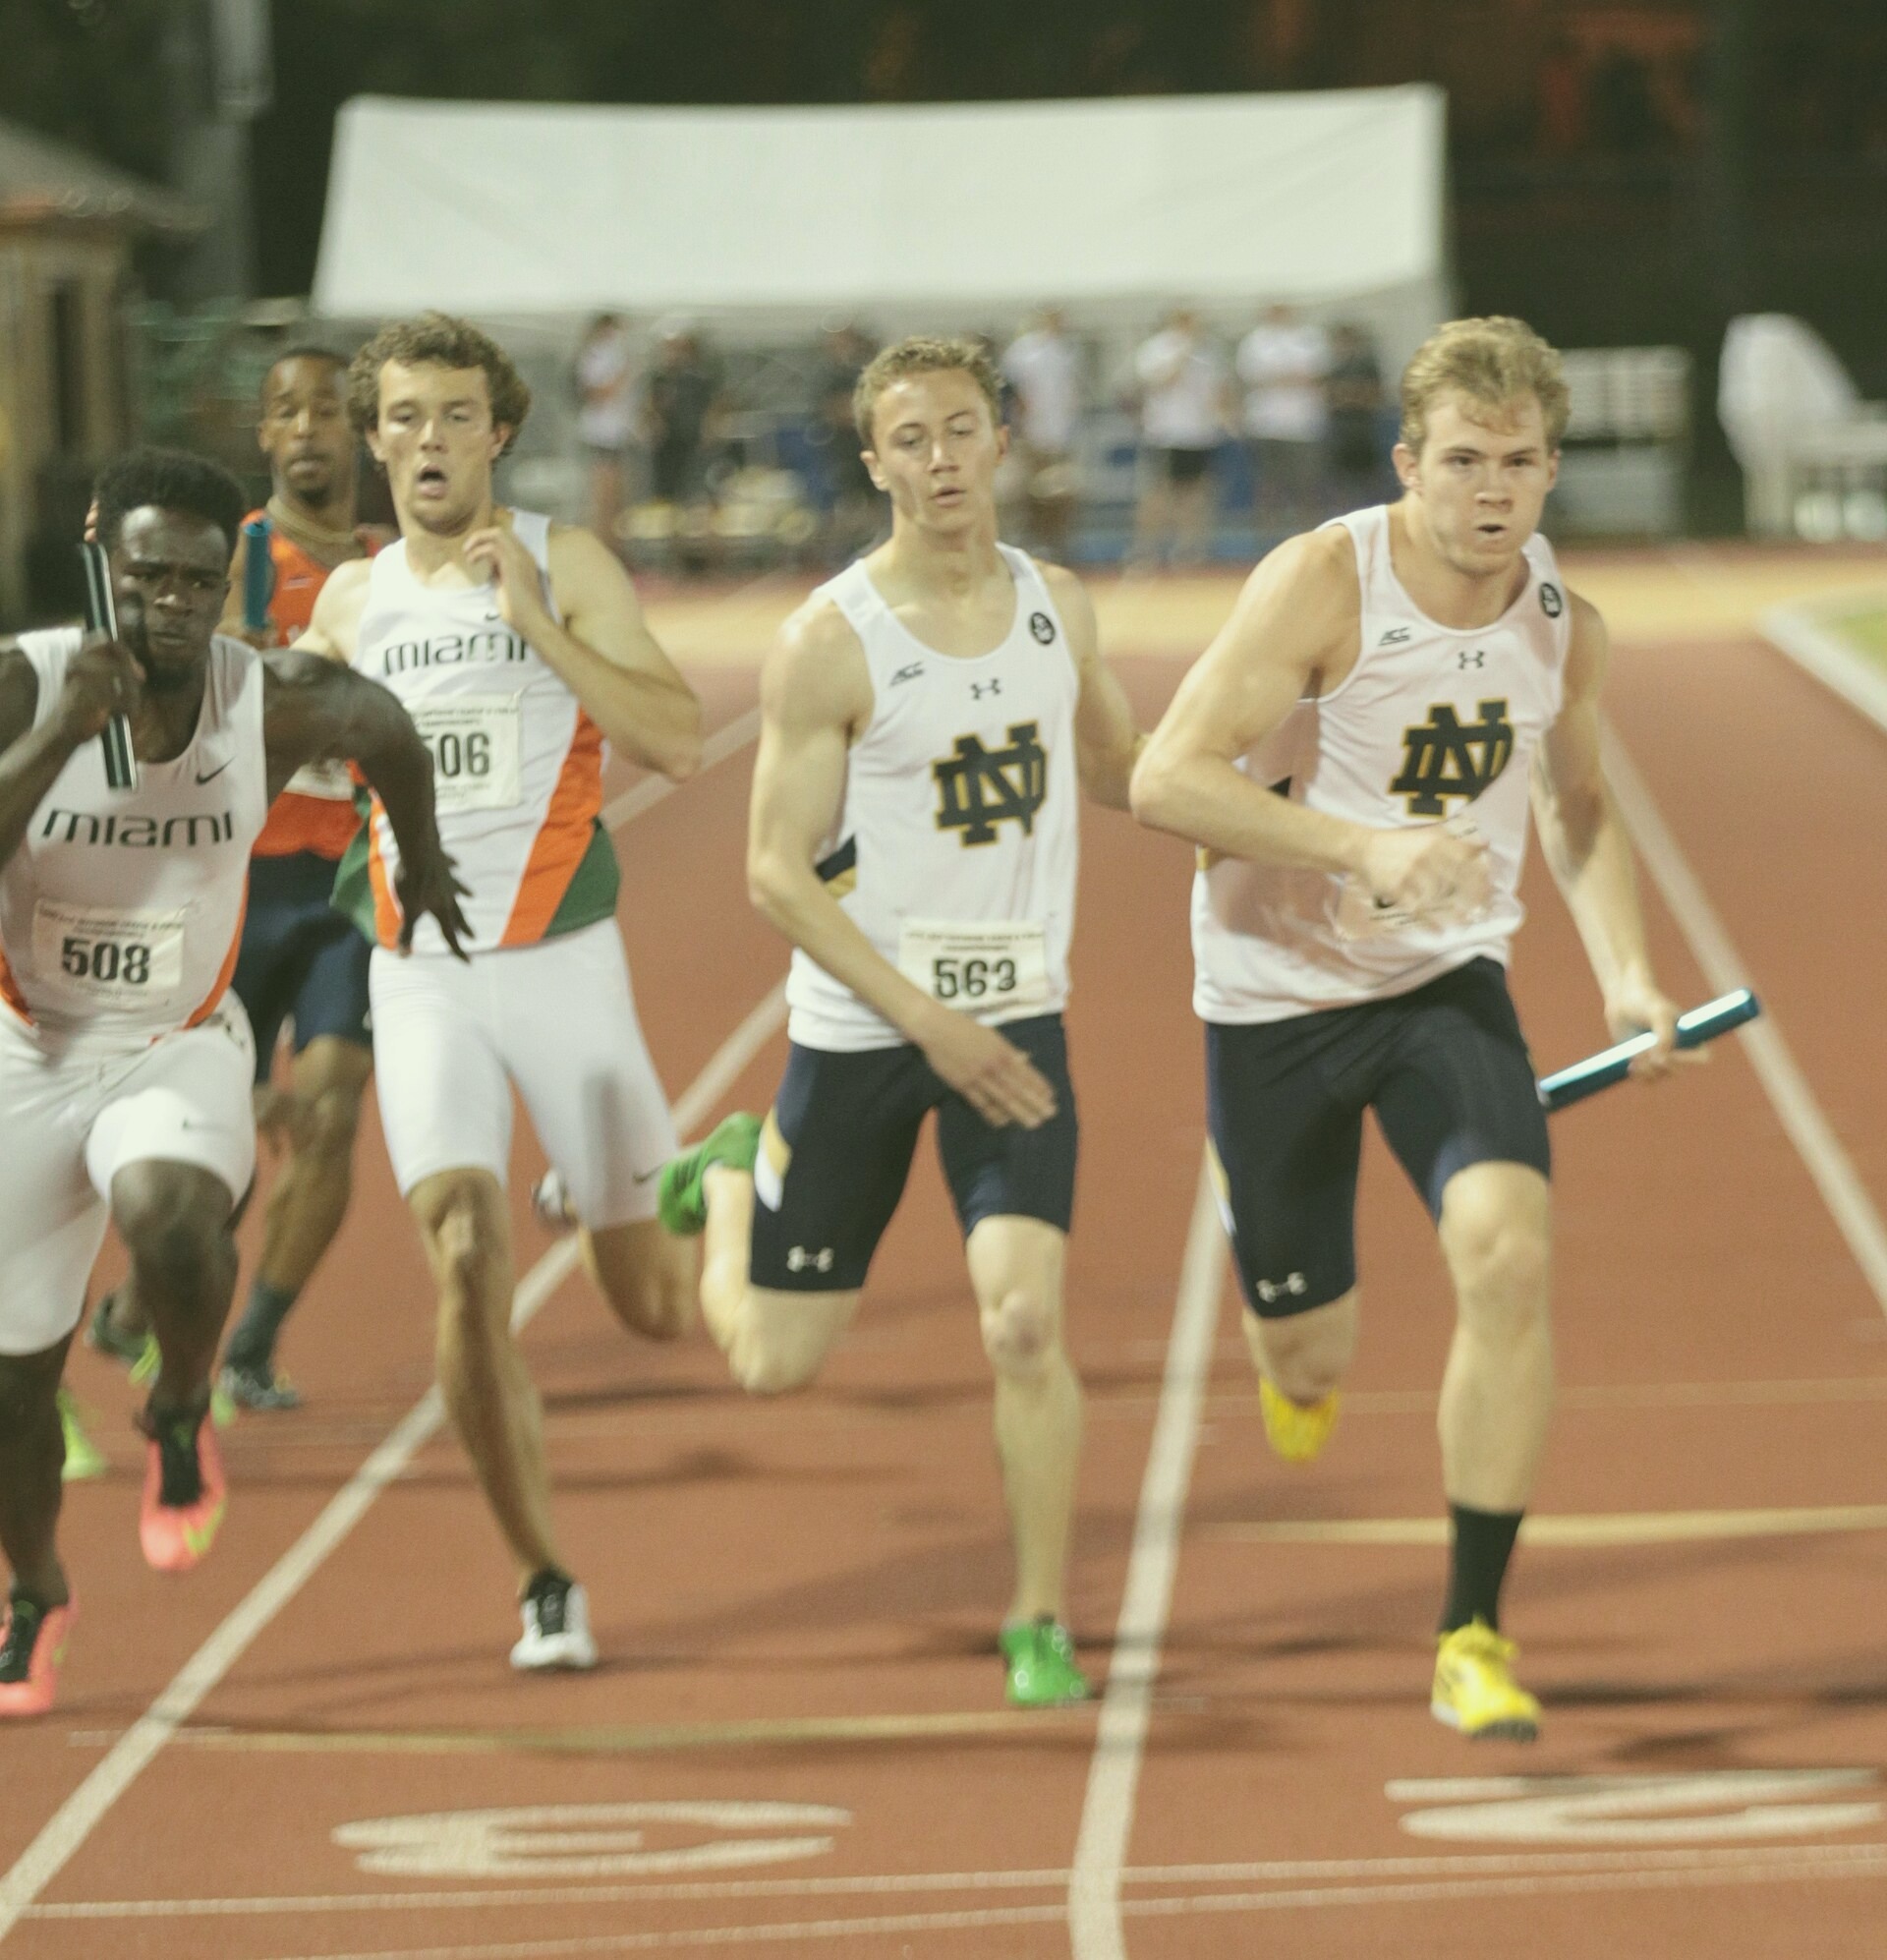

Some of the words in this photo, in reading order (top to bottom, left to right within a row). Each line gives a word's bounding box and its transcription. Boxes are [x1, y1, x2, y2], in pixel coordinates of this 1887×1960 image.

[420, 732, 490, 778] 06
[61, 936, 150, 984] 508
[934, 957, 1016, 999] 563
